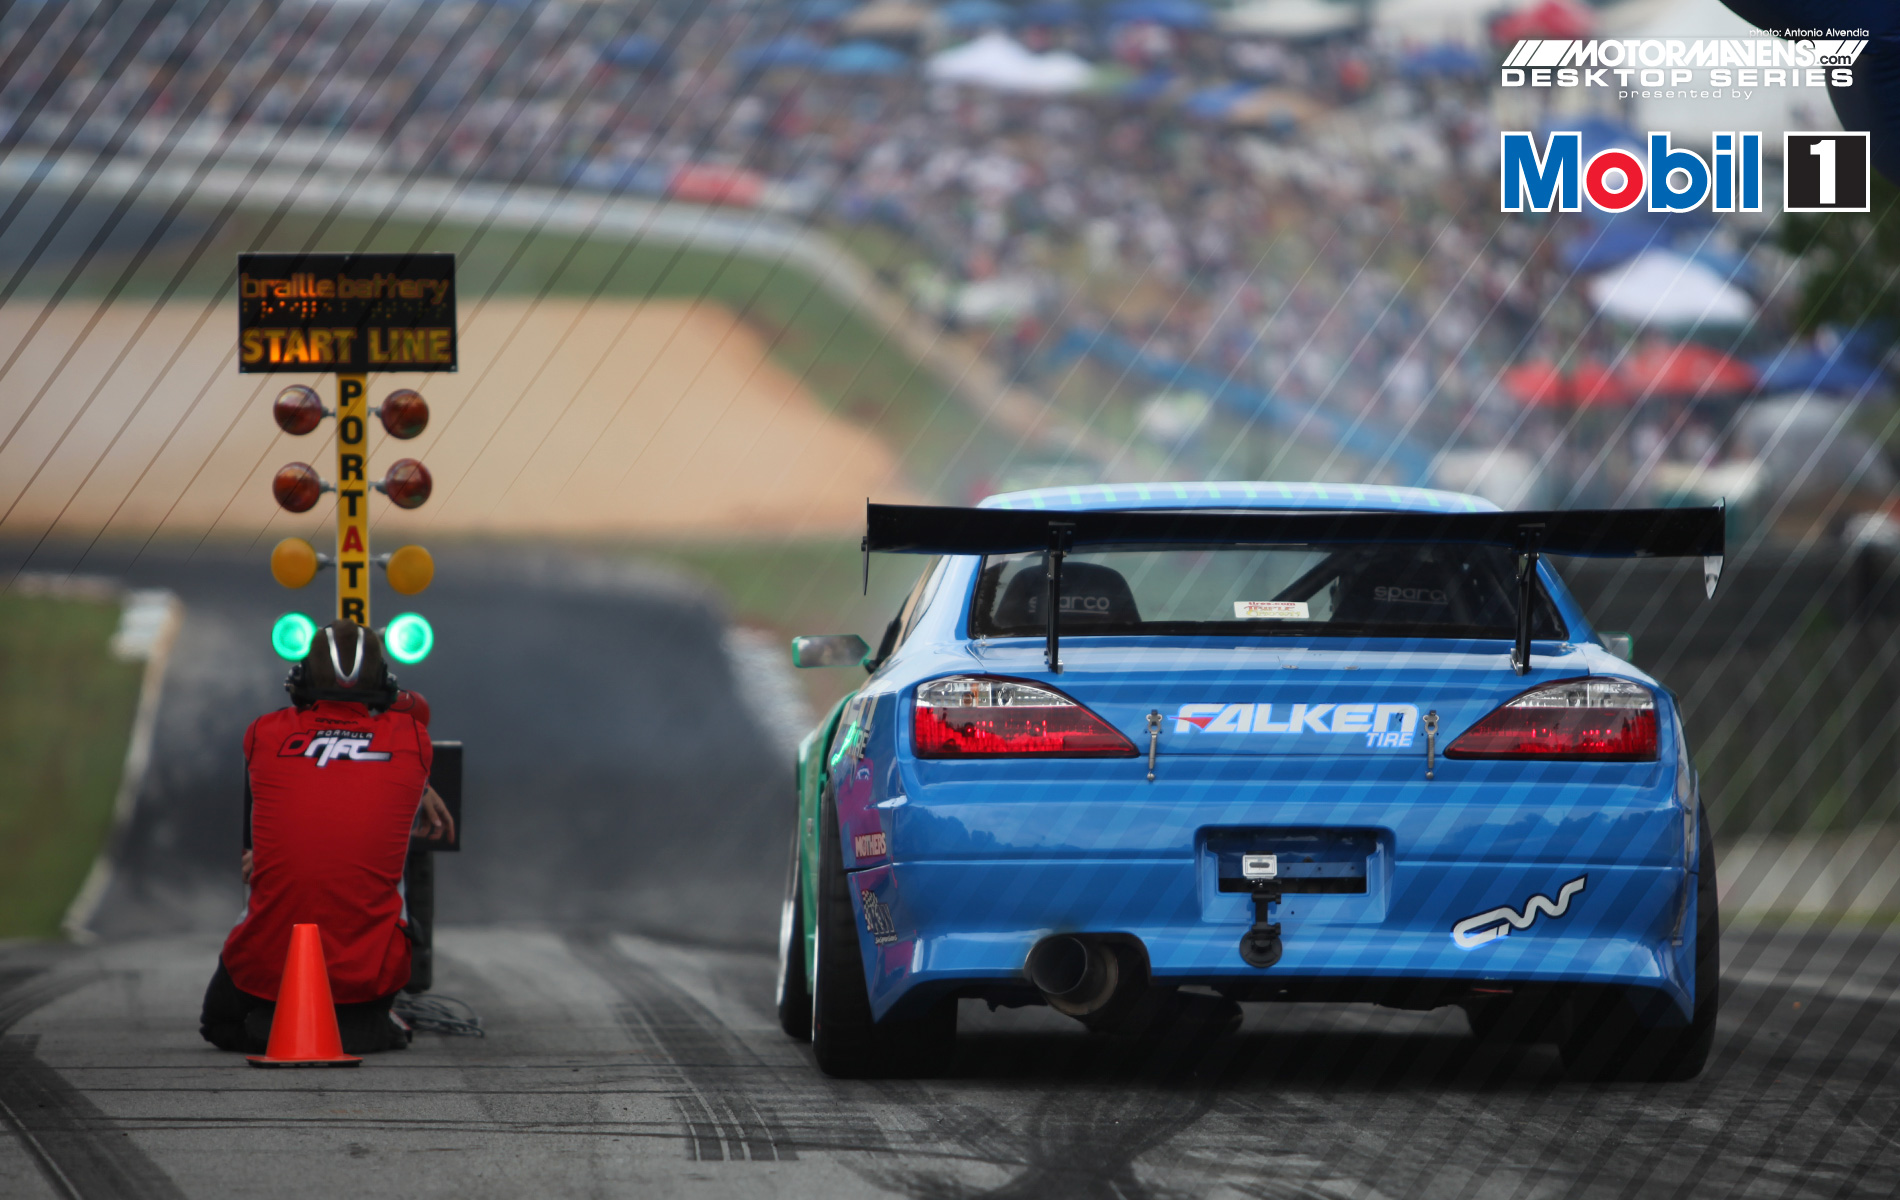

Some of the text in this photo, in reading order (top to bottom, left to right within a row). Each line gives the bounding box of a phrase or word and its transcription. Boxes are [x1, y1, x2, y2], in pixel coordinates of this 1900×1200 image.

[241, 327, 452, 363] START LINE
[1172, 703, 1419, 733] FALKEN
[316, 729, 374, 739] FORMULA
[1366, 732, 1415, 748] TIRE
[854, 832, 887, 858] MOTHERS
